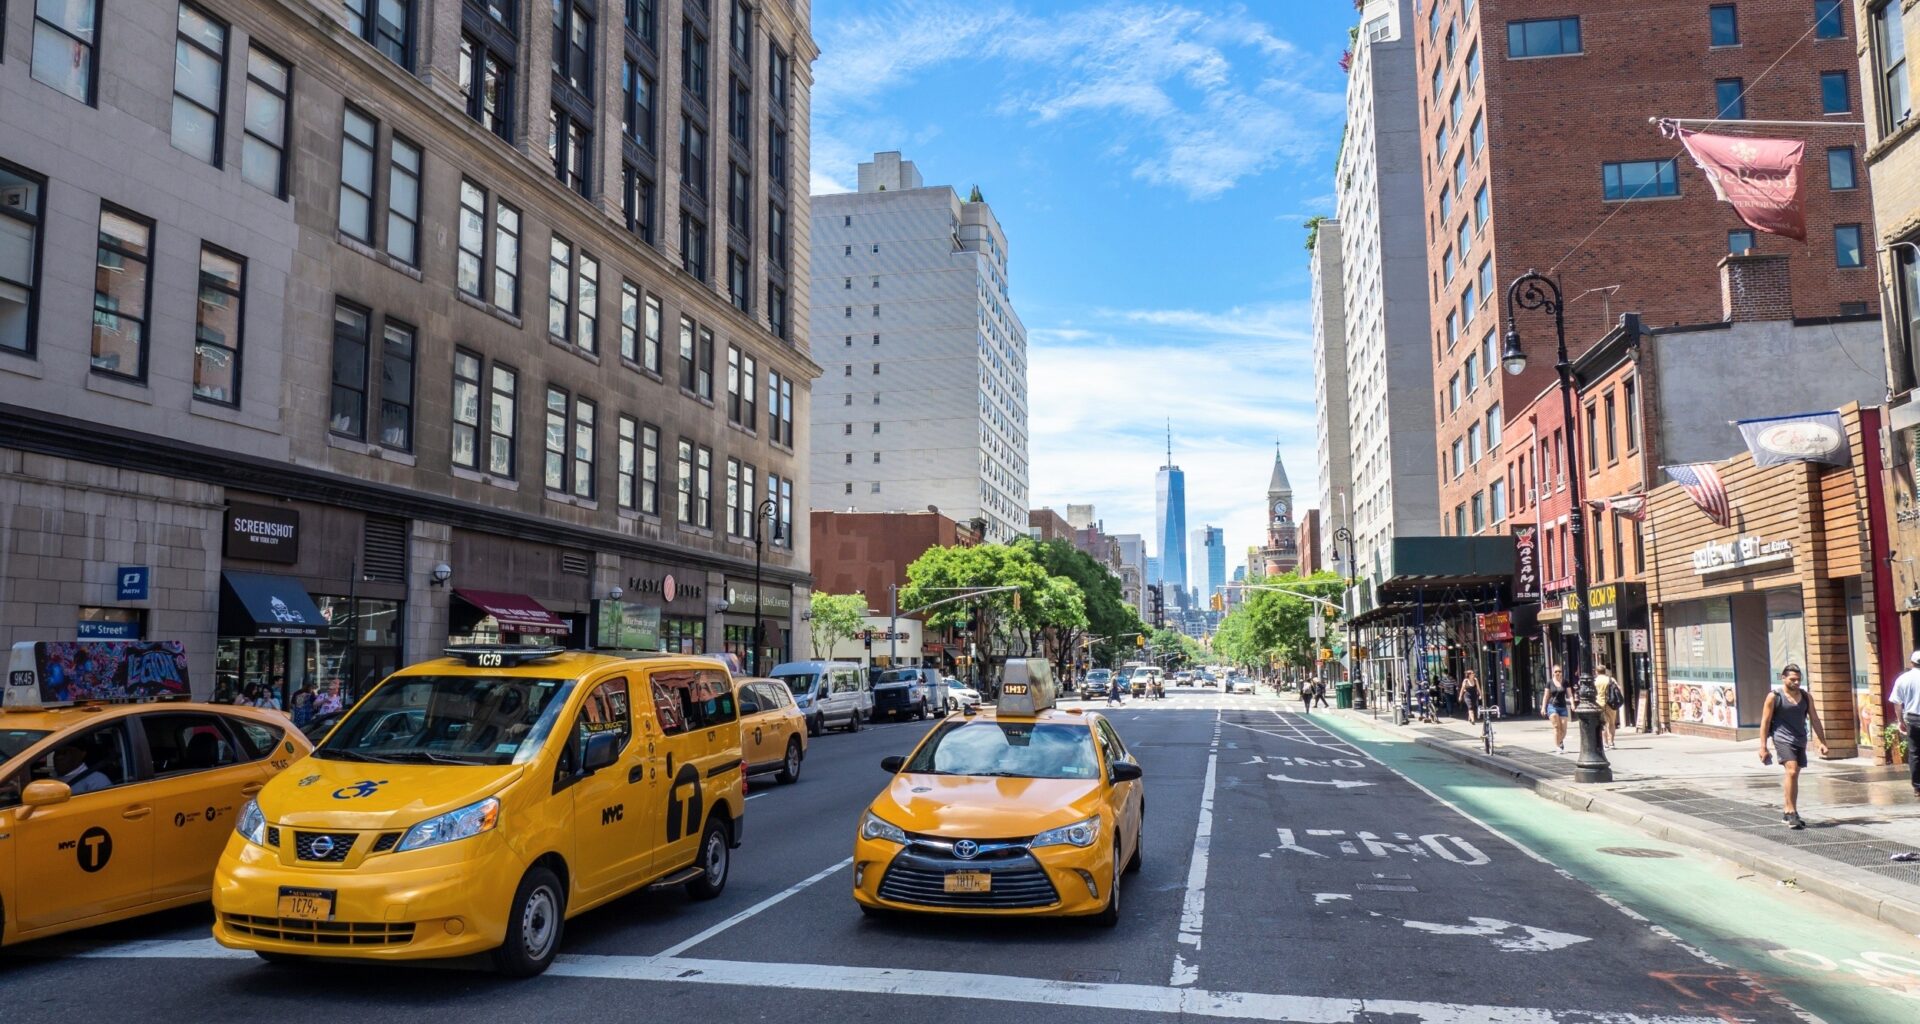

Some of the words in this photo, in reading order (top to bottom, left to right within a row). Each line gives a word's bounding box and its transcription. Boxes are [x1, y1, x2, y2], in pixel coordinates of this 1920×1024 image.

[234, 518, 294, 538] SCREENSHOT
[1520, 547, 1535, 592] ASAMI
[98, 625, 123, 634] Street
[127, 652, 183, 685] LEGION
[478, 653, 502, 666] 1C79
[14, 673, 33, 685] 9K45
[1004, 685, 1027, 694] 1H17
[1239, 756, 1366, 768] ONLY
[602, 803, 624, 826] NYC
[58, 841, 76, 850] NYC
[85, 835, 105, 867] T
[1258, 828, 1491, 866] ONLY
